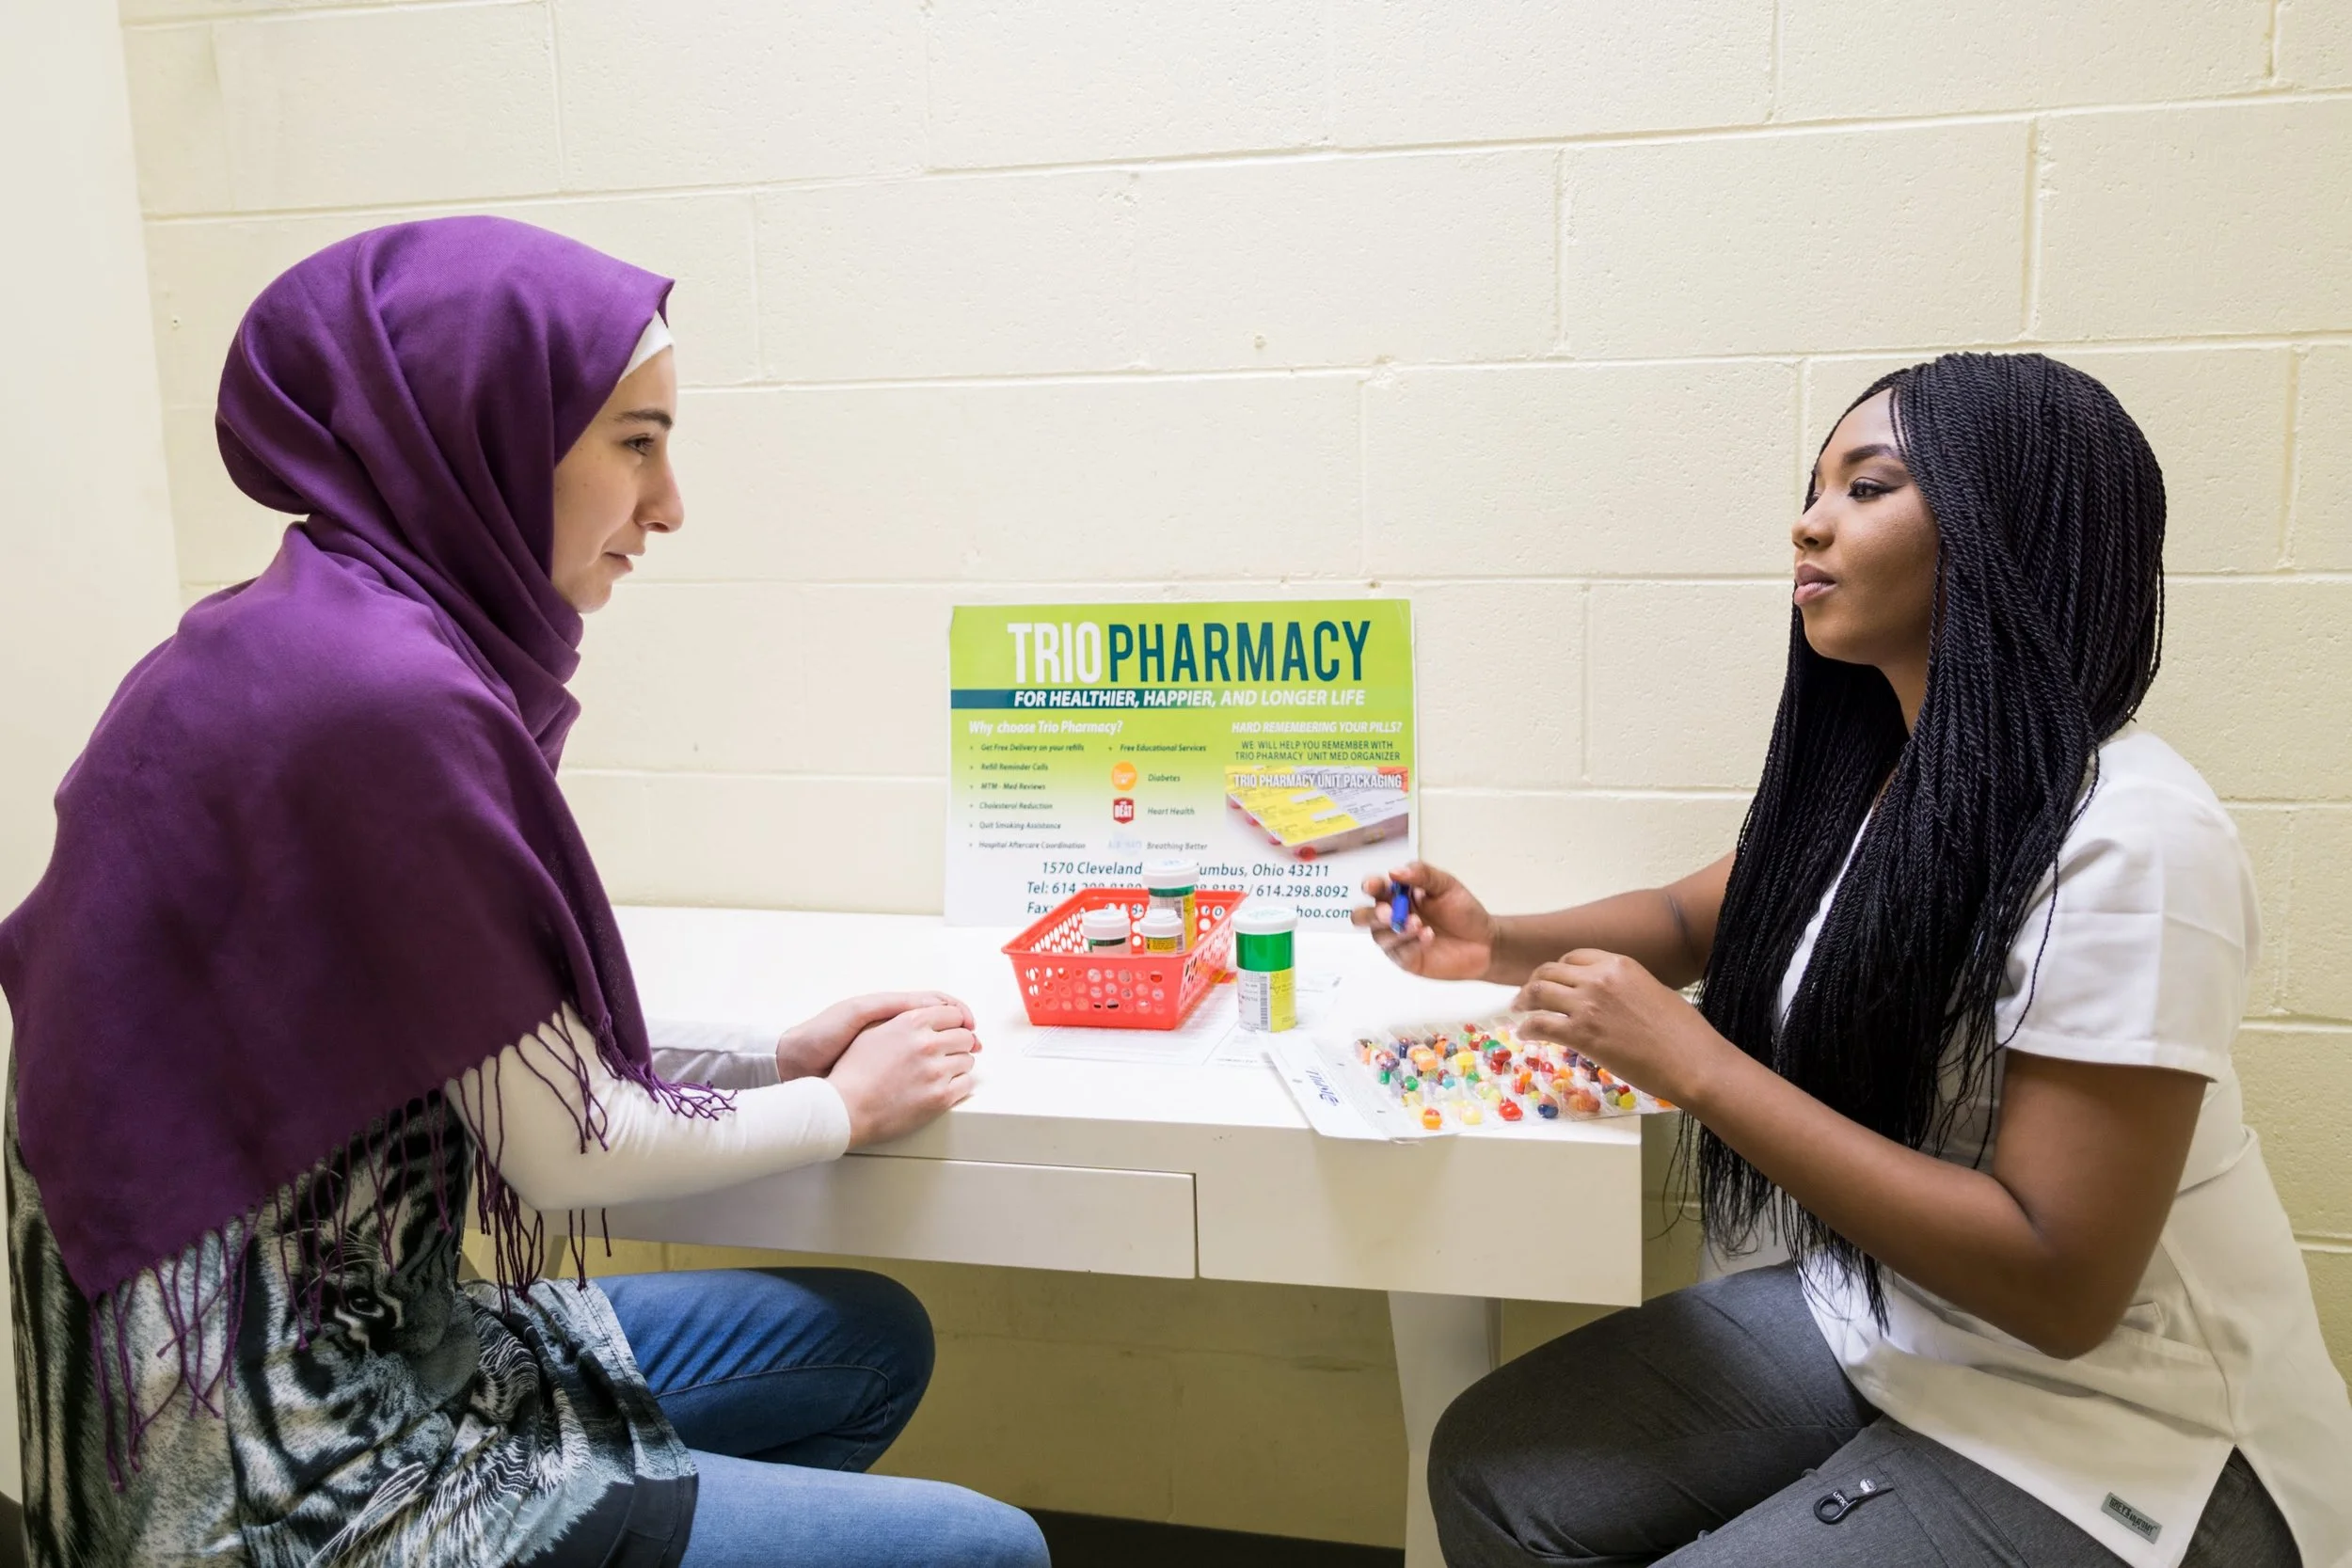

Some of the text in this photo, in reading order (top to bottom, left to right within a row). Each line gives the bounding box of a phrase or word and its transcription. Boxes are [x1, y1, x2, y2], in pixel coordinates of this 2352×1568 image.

[1007, 620, 1371, 684] TRIO PHARMACY
[1014, 689, 1366, 708] FOR HEALTHIER, HAPPIER, AND LONGER LIFE
[968, 721, 1123, 736] Why choose Trio Pharmacy?
[1232, 721, 1403, 734] HARD REMEMBERING YOUR PILLS?
[980, 743, 993, 752] Get
[994, 743, 1009, 752] Free
[1009, 743, 1037, 753] Delivery
[1048, 745, 1064, 753] your
[1065, 743, 1085, 752] refills
[1120, 743, 1207, 752] Free Educational Services
[1242, 741, 1392, 750] WE WILL HELP YOU REMEMBER WITH
[1235, 752, 1400, 761] TRIO PHARMACY UNIT MED ORGANIZER
[980, 762, 1049, 771] Refill Reminder Calls
[1148, 773, 1181, 782] Diabetes
[1234, 774, 1402, 788] TRIO PHARMACY UNIT PACKAGING
[1147, 806, 1195, 815] Heart Health
[995, 821, 1025, 831] Smoking
[979, 841, 1007, 849] Hospital
[1041, 841, 1086, 849] Coordination
[1147, 842, 1184, 851] Breathing
[1043, 862, 1143, 875] 1570 Cleveland
[1197, 863, 1328, 878] umbus, Ohio 43211
[1027, 881, 1049, 894] Tel:
[1256, 885, 1349, 897] 614.298.8092
